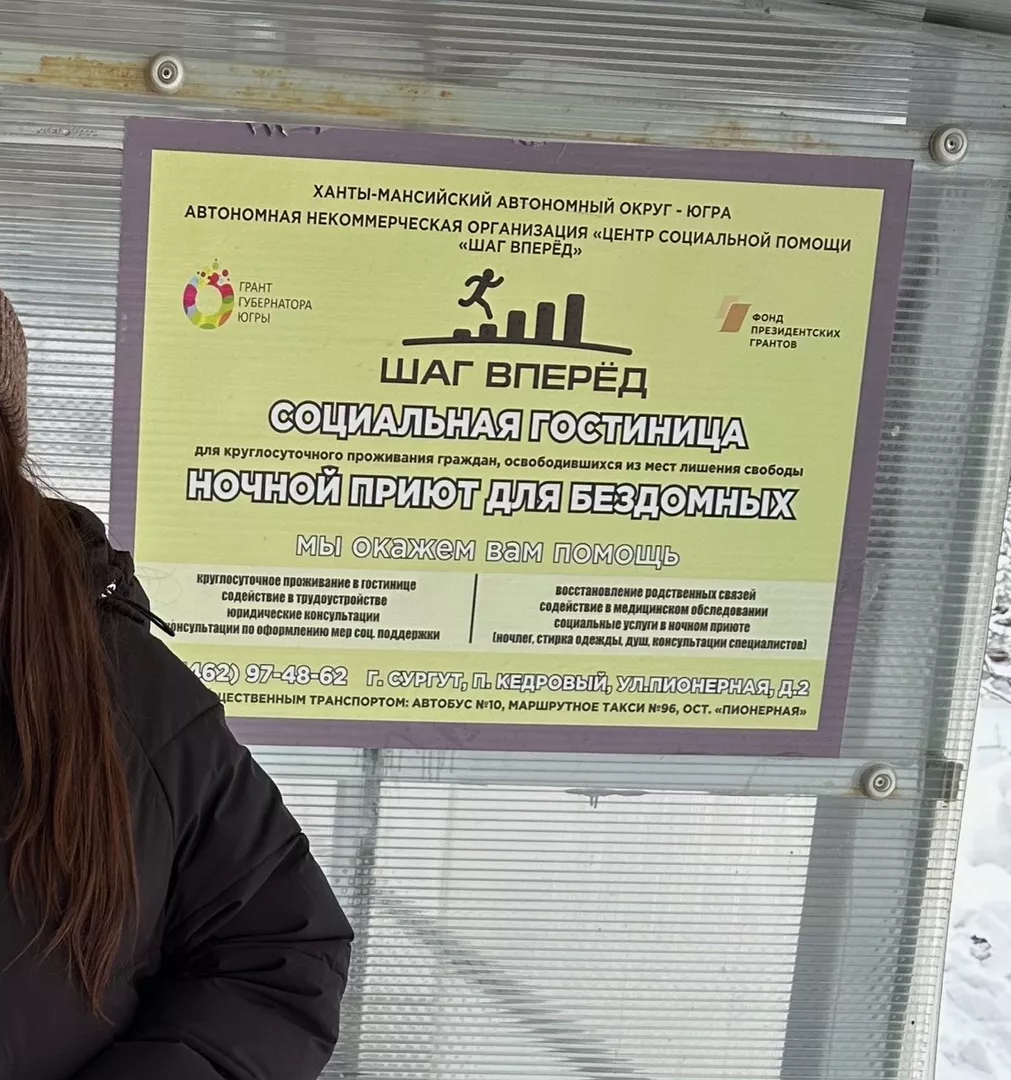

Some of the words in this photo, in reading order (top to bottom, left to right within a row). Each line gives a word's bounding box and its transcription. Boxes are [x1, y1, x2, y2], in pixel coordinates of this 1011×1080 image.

[313, 184, 492, 208] ХАНТЫ-МАНСИЙСКИЙ
[496, 195, 615, 214] АВТОНОМНЫЙ
[619, 202, 672, 217] ОКРУГ
[687, 205, 732, 220] ЮГРА
[184, 204, 302, 224] АВТОНОМНАЯ
[306, 211, 463, 234] НЕКОММЕРЧЕСКАЯ
[468, 219, 588, 242] ОРГАНИЗАЦИЯ
[592, 227, 654, 243] «ЦЕНТР
[659, 230, 771, 249] СОЦИАЛЬНОЙ
[776, 235, 852, 253] ПОМОЩИ
[458, 238, 506, 253] «ШАГ
[511, 240, 582, 258] ВПЕРЁД»
[239, 281, 273, 293] ГРАНТ
[238, 296, 312, 311] ГУБЕРНАТОРА
[237, 312, 271, 324] ЮГРЫ
[752, 312, 784, 324] ФОНД
[751, 325, 840, 339] ПРЕЗИДЕНТСКИХ
[749, 337, 798, 349] ГРАНТОВ
[380, 357, 474, 386] ШАГ
[486, 361, 648, 399] ВПЕРЁД
[269, 399, 524, 442] СОЦИАЛЬНАЯ
[529, 408, 749, 453] ГОСТИНИЦА
[194, 446, 220, 457] для
[224, 447, 343, 462] круглосуточного
[347, 451, 434, 465] проживания
[437, 455, 501, 468] граждан,
[504, 456, 622, 471] освободившихся
[626, 461, 642, 471] из
[645, 461, 677, 473] мест
[679, 462, 741, 475] лишения
[744, 464, 804, 478] свободы
[187, 465, 343, 505] НОЧНОЙ
[348, 473, 480, 510] ПРИЮТ
[483, 479, 563, 517] ДЛЯ
[568, 481, 797, 521] БЕЗДОМНЫХ
[296, 534, 343, 558] мы
[351, 536, 476, 562] окажем
[486, 540, 543, 564] вам
[553, 542, 680, 570] помощь
[196, 573, 281, 588] круглосуточное
[283, 576, 351, 589] проживание
[352, 579, 359, 588] в
[361, 579, 417, 591] гостинице
[221, 589, 285, 604] содействие
[287, 593, 294, 602] в
[296, 592, 388, 607] трудоустройстве
[555, 585, 643, 597] восстановление
[645, 587, 716, 600] родственных
[718, 588, 756, 600] связей
[226, 607, 302, 621] юридические
[304, 611, 380, 624] консультации
[539, 600, 603, 614] содействие
[605, 604, 612, 613] в
[613, 604, 689, 616] медицинском
[691, 604, 768, 617] обследовании
[242, 625, 256, 634] по
[257, 625, 329, 639] оформлению
[331, 628, 352, 640] мер
[354, 629, 376, 640] соц.
[377, 629, 440, 641] поддержки
[554, 617, 621, 630] социальные
[623, 620, 658, 632] услуги
[660, 621, 666, 630] в
[668, 621, 709, 632] ночном
[710, 623, 750, 634] приюте
[536, 634, 573, 645] стирка
[575, 635, 623, 647] одежды,
[625, 637, 650, 648] душ,
[652, 637, 727, 649] консультации
[183, 661, 240, 686] 462)
[245, 663, 348, 686] 97-48-62
[366, 670, 384, 687] Г.
[387, 671, 468, 692] СУРГУТ,
[472, 673, 491, 690] П.
[496, 671, 612, 694] КЕДРОВЫЙ,
[777, 680, 810, 699] Д.2
[310, 695, 409, 708] ТРАНСПОРТОМ:
[411, 698, 472, 710] АВТОБУС
[476, 700, 505, 712] №10,
[508, 700, 599, 713] МАРШРУТНОЕ
[603, 703, 645, 714] ТАКСИ
[648, 703, 680, 715] №96,
[683, 704, 711, 715] ОСТ.
[715, 705, 806, 717] «ПИОНЕРНАЯ»
